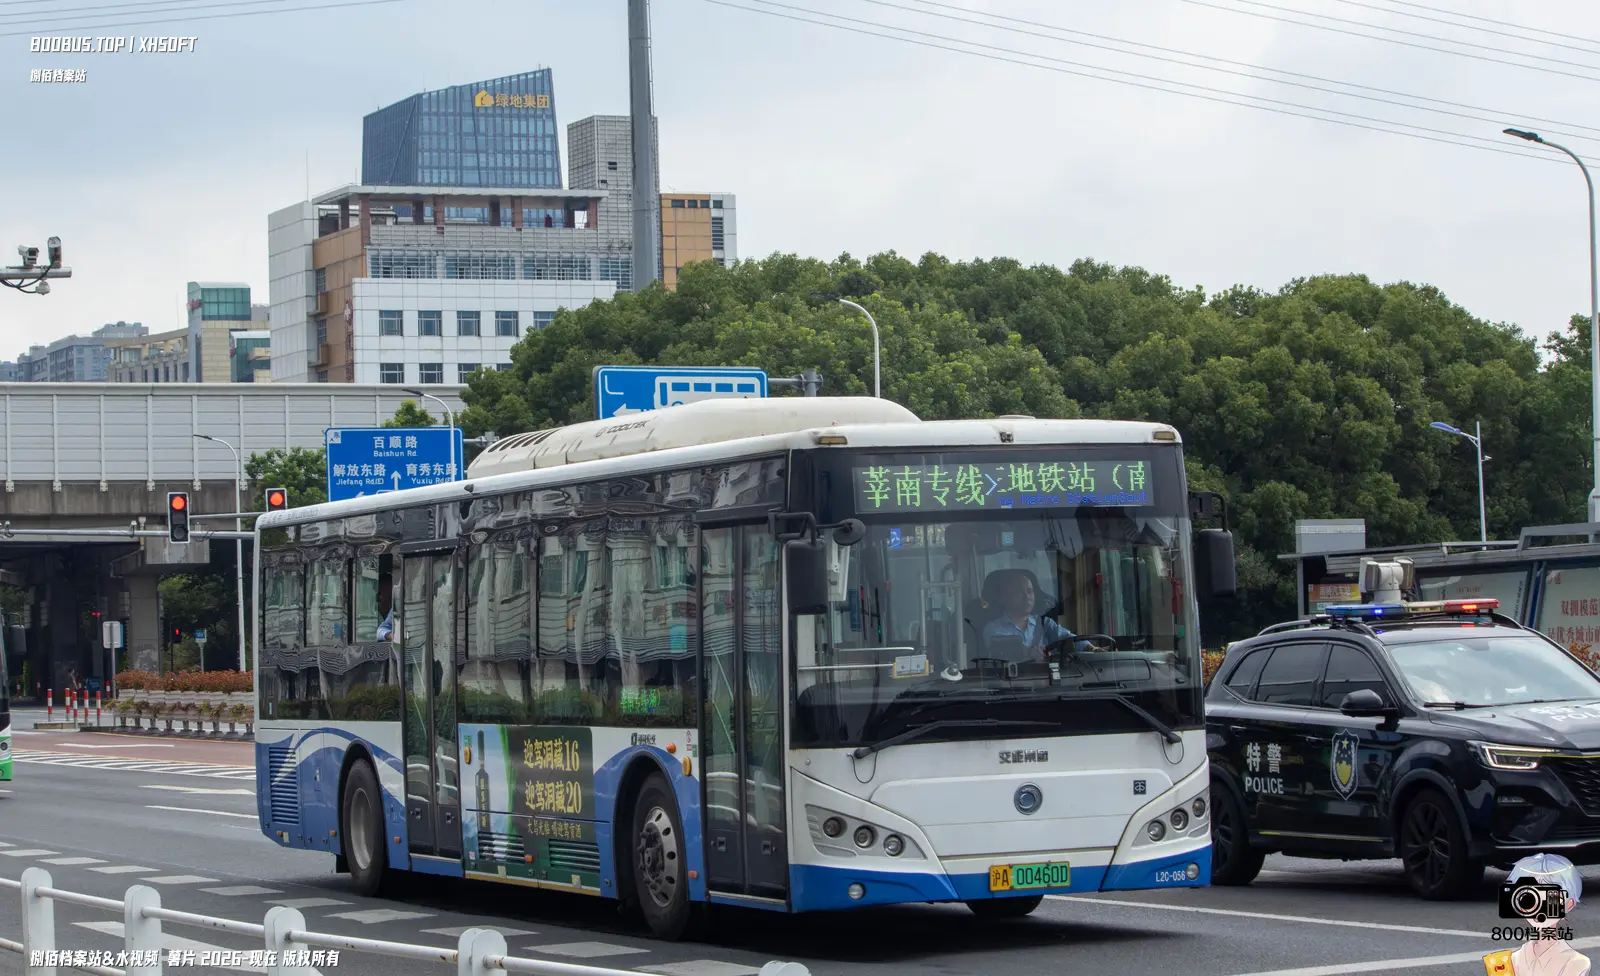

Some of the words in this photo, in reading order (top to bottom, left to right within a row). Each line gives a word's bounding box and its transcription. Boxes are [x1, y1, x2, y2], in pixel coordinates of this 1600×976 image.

[495, 94, 550, 108] 绿地集团
[373, 436, 418, 449] 百顺路
[333, 463, 386, 477] 解放东路
[405, 462, 458, 476] 育秀东路
[336, 478, 362, 486] Jiefang
[411, 477, 433, 485] Yuxiu
[862, 464, 985, 508] 莘南专线
[1021, 493, 1061, 505] Metro
[523, 738, 580, 772] 迎驾洞藏16
[1246, 742, 1282, 773] 特警
[1244, 776, 1284, 794] POLICE
[525, 780, 582, 814] 迎驾洞藏20
[1155, 870, 1186, 882] L2C-056
